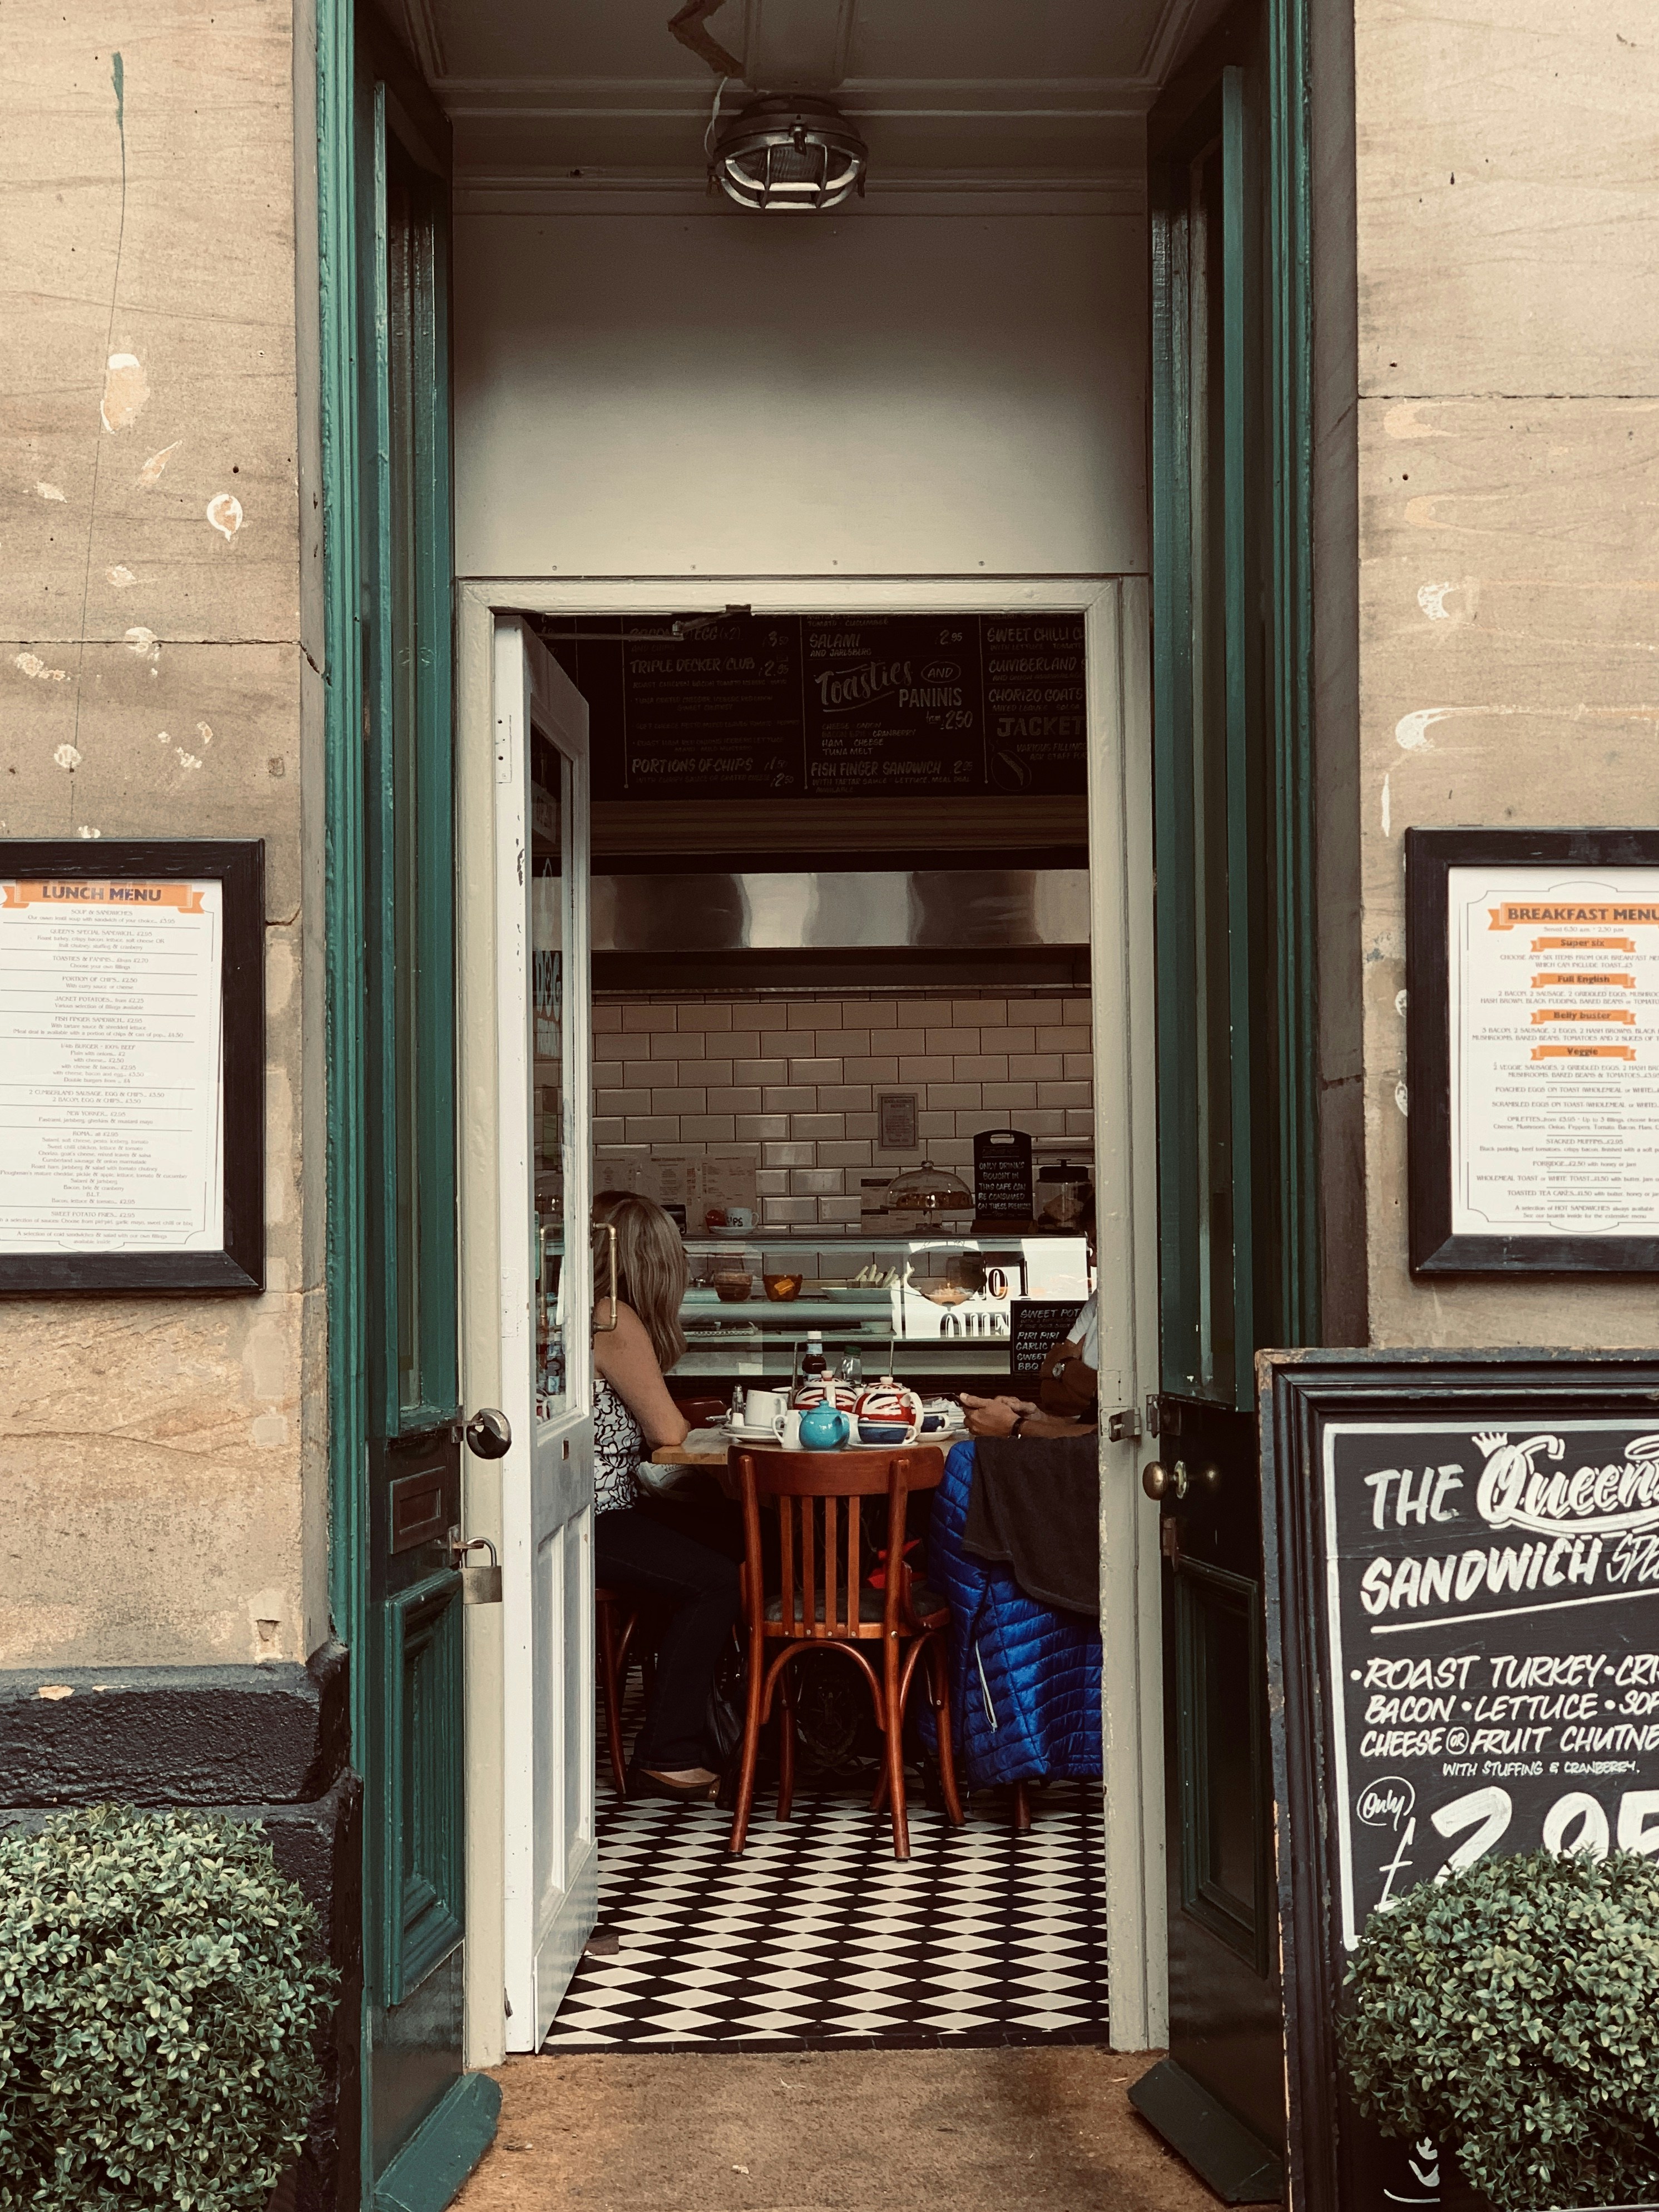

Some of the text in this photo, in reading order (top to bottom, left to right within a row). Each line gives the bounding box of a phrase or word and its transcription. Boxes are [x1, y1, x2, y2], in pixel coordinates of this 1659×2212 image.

[694, 628, 718, 641] EGG
[809, 633, 860, 648] SALAMI
[987, 627, 1031, 642] SWEET
[1033, 626, 1069, 641] CHILLI
[630, 659, 673, 675] TRIPLE
[989, 656, 1077, 673] CUMBERLAND
[815, 661, 953, 706] Toasties AND
[899, 687, 963, 707] PANINIS
[1044, 687, 1084, 702] GOATS
[872, 729, 917, 738] CRANBERRY
[821, 738, 884, 748] HAM CHEESE
[822, 747, 874, 756] TUNA MELT
[632, 758, 696, 774] PORTIONS
[714, 758, 754, 772] CHIPS
[810, 761, 836, 776] FISH
[840, 761, 879, 776] FINGER
[882, 760, 943, 775] SANDWICH
[42, 886, 161, 902] LUNCH MENU
[1508, 908, 1609, 921] BREAKFAST
[1561, 939, 1590, 948] Super
[1557, 975, 1611, 985] Full English
[1553, 1011, 1577, 1021] Belly
[1567, 1047, 1599, 1057] Veggie
[979, 1161, 1025, 1170] ONLY DRINKS
[983, 1172, 1011, 1180] BOUGHT
[978, 1182, 994, 1191] THIS
[1013, 1182, 1026, 1191] CAN
[978, 1192, 987, 1201] BE
[1019, 1308, 1081, 1319] SWEET POT
[1017, 1332, 1038, 1340] PIRI
[1016, 1342, 1049, 1351] GARLIC
[1017, 1353, 1047, 1361] SWEET
[1018, 1362, 1039, 1371] BBQ
[1364, 1463, 1464, 1530] THE
[1360, 1533, 1659, 1615] SANDWICH SPE
[1363, 1654, 1659, 1690] ROAST TURKEY CRI
[1364, 1695, 1457, 1724] BACON
[1474, 1693, 1599, 1721] LETTUCE
[1360, 1727, 1447, 1758] CHEESE
[1468, 1726, 1553, 1754] FRUIT
[1443, 1761, 1477, 1776] WITH
[1482, 1761, 1544, 1776] STUFFING
[1363, 1789, 1406, 1831] Only
